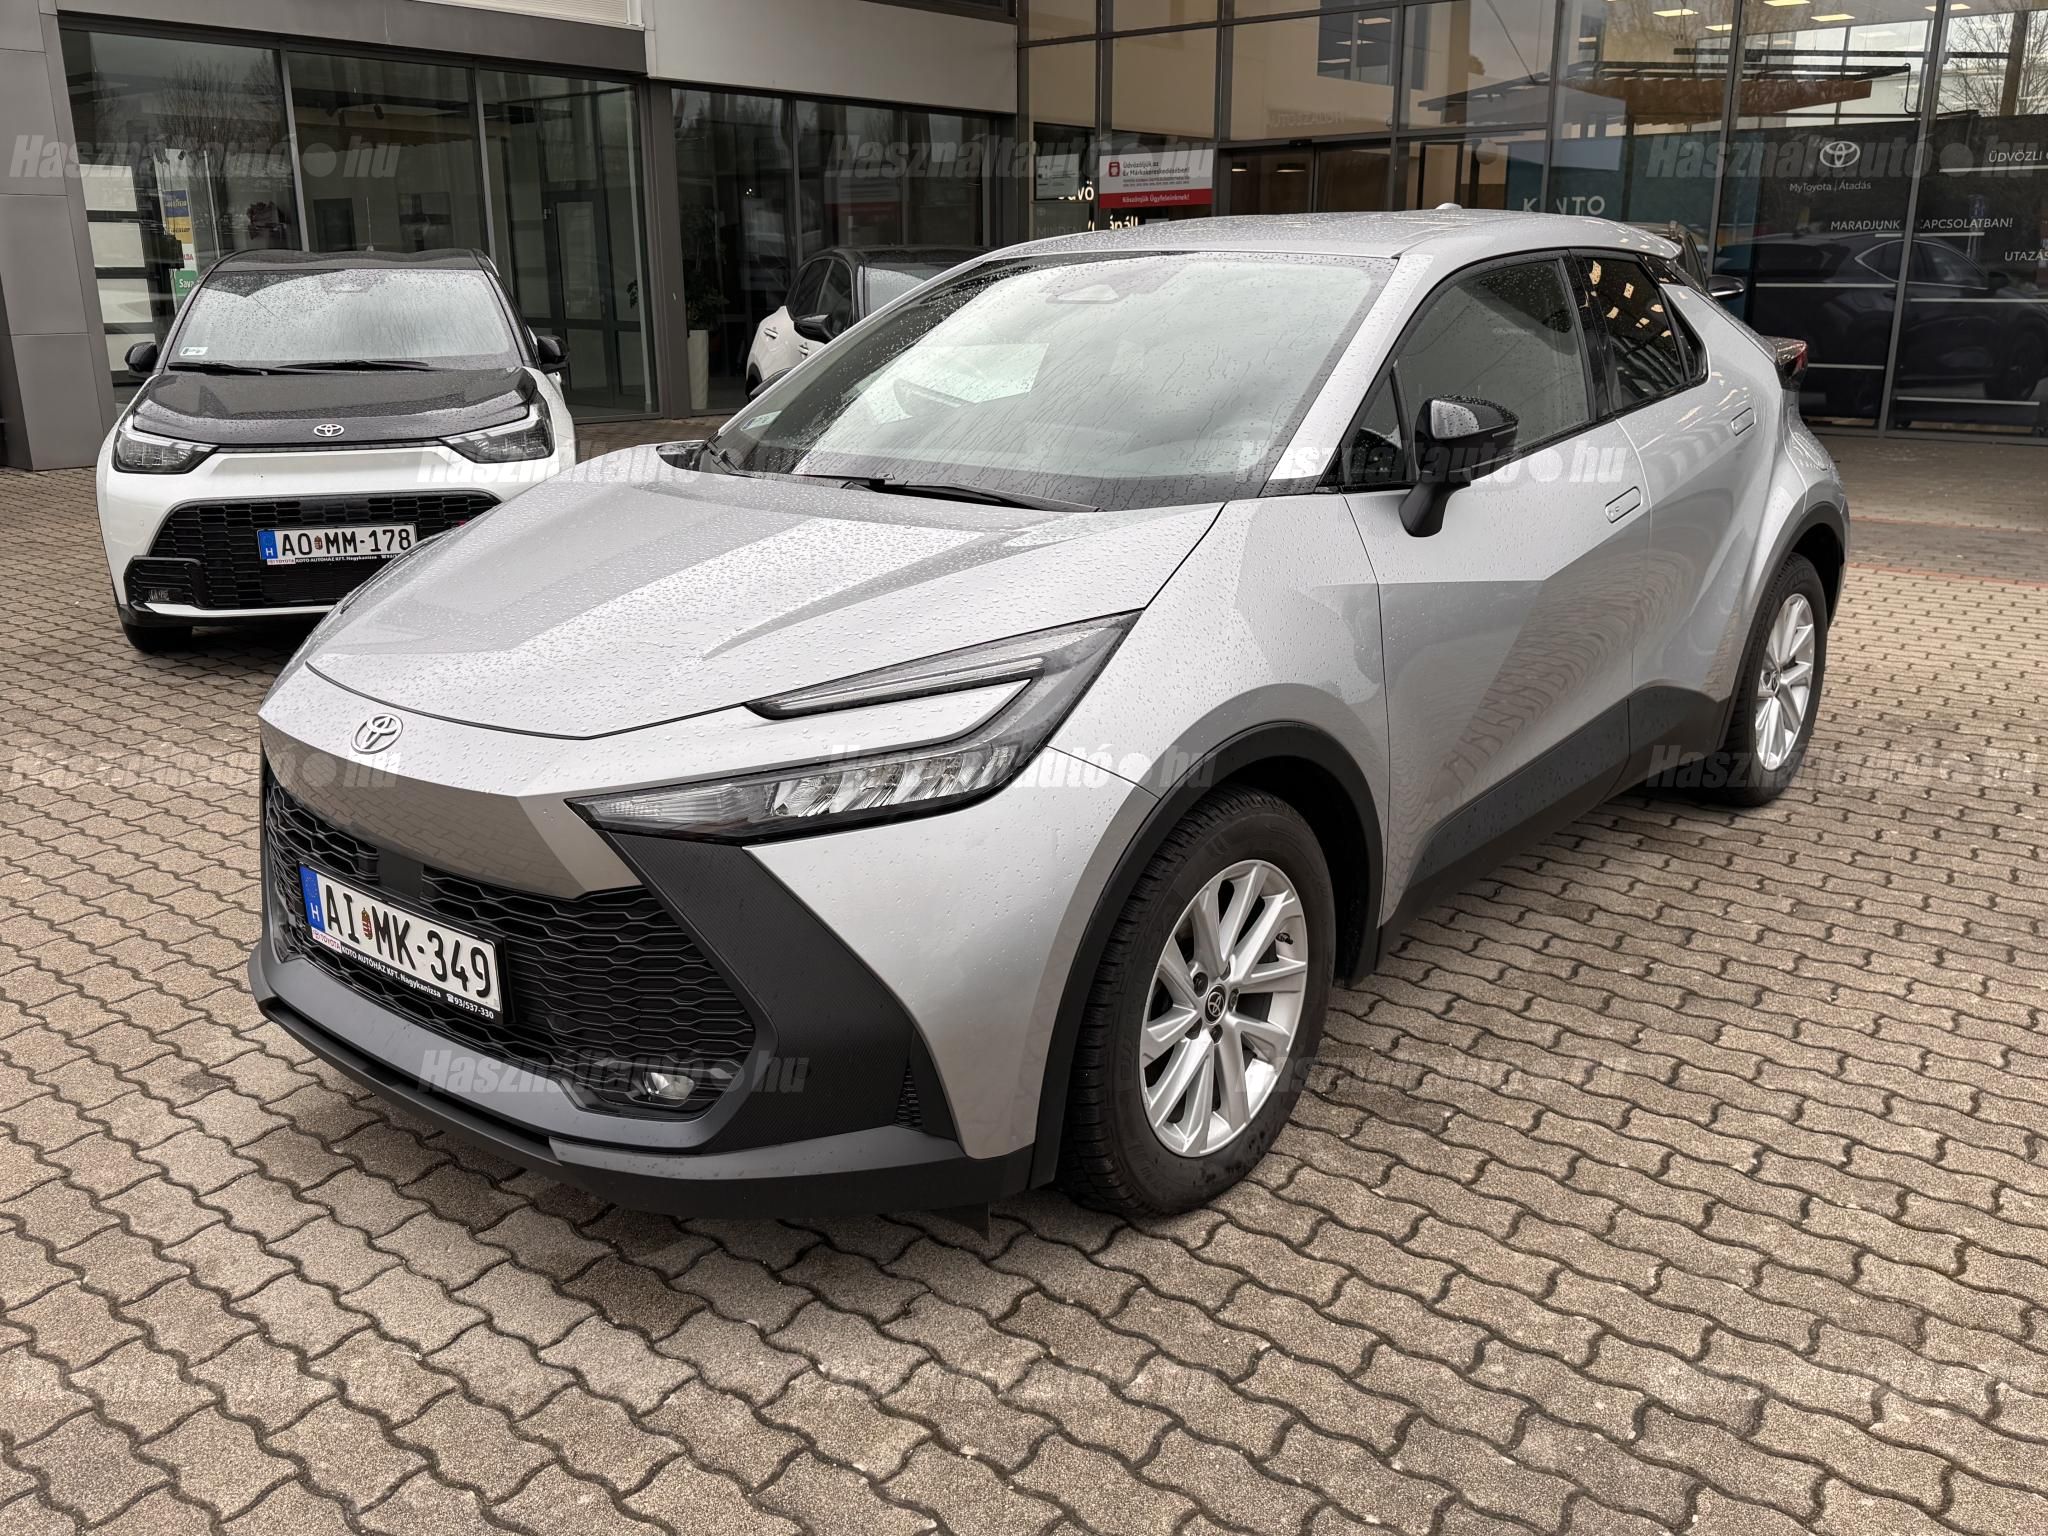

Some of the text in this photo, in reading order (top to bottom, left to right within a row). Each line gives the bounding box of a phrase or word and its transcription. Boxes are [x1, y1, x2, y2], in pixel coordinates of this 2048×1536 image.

[1789, 180, 1872, 193] MyToyota Átadás
[1523, 195, 1605, 215] KNTO
[1830, 218, 2013, 231] MARADJUNK APCSOLATBAN!
[265, 548, 274, 556] H
[282, 529, 411, 556] AO MM-178
[310, 903, 320, 922] H
[325, 884, 491, 998] AI MK-349
[320, 932, 342, 951] TOYOTA
[400, 975, 441, 998] Nagykanizsa
